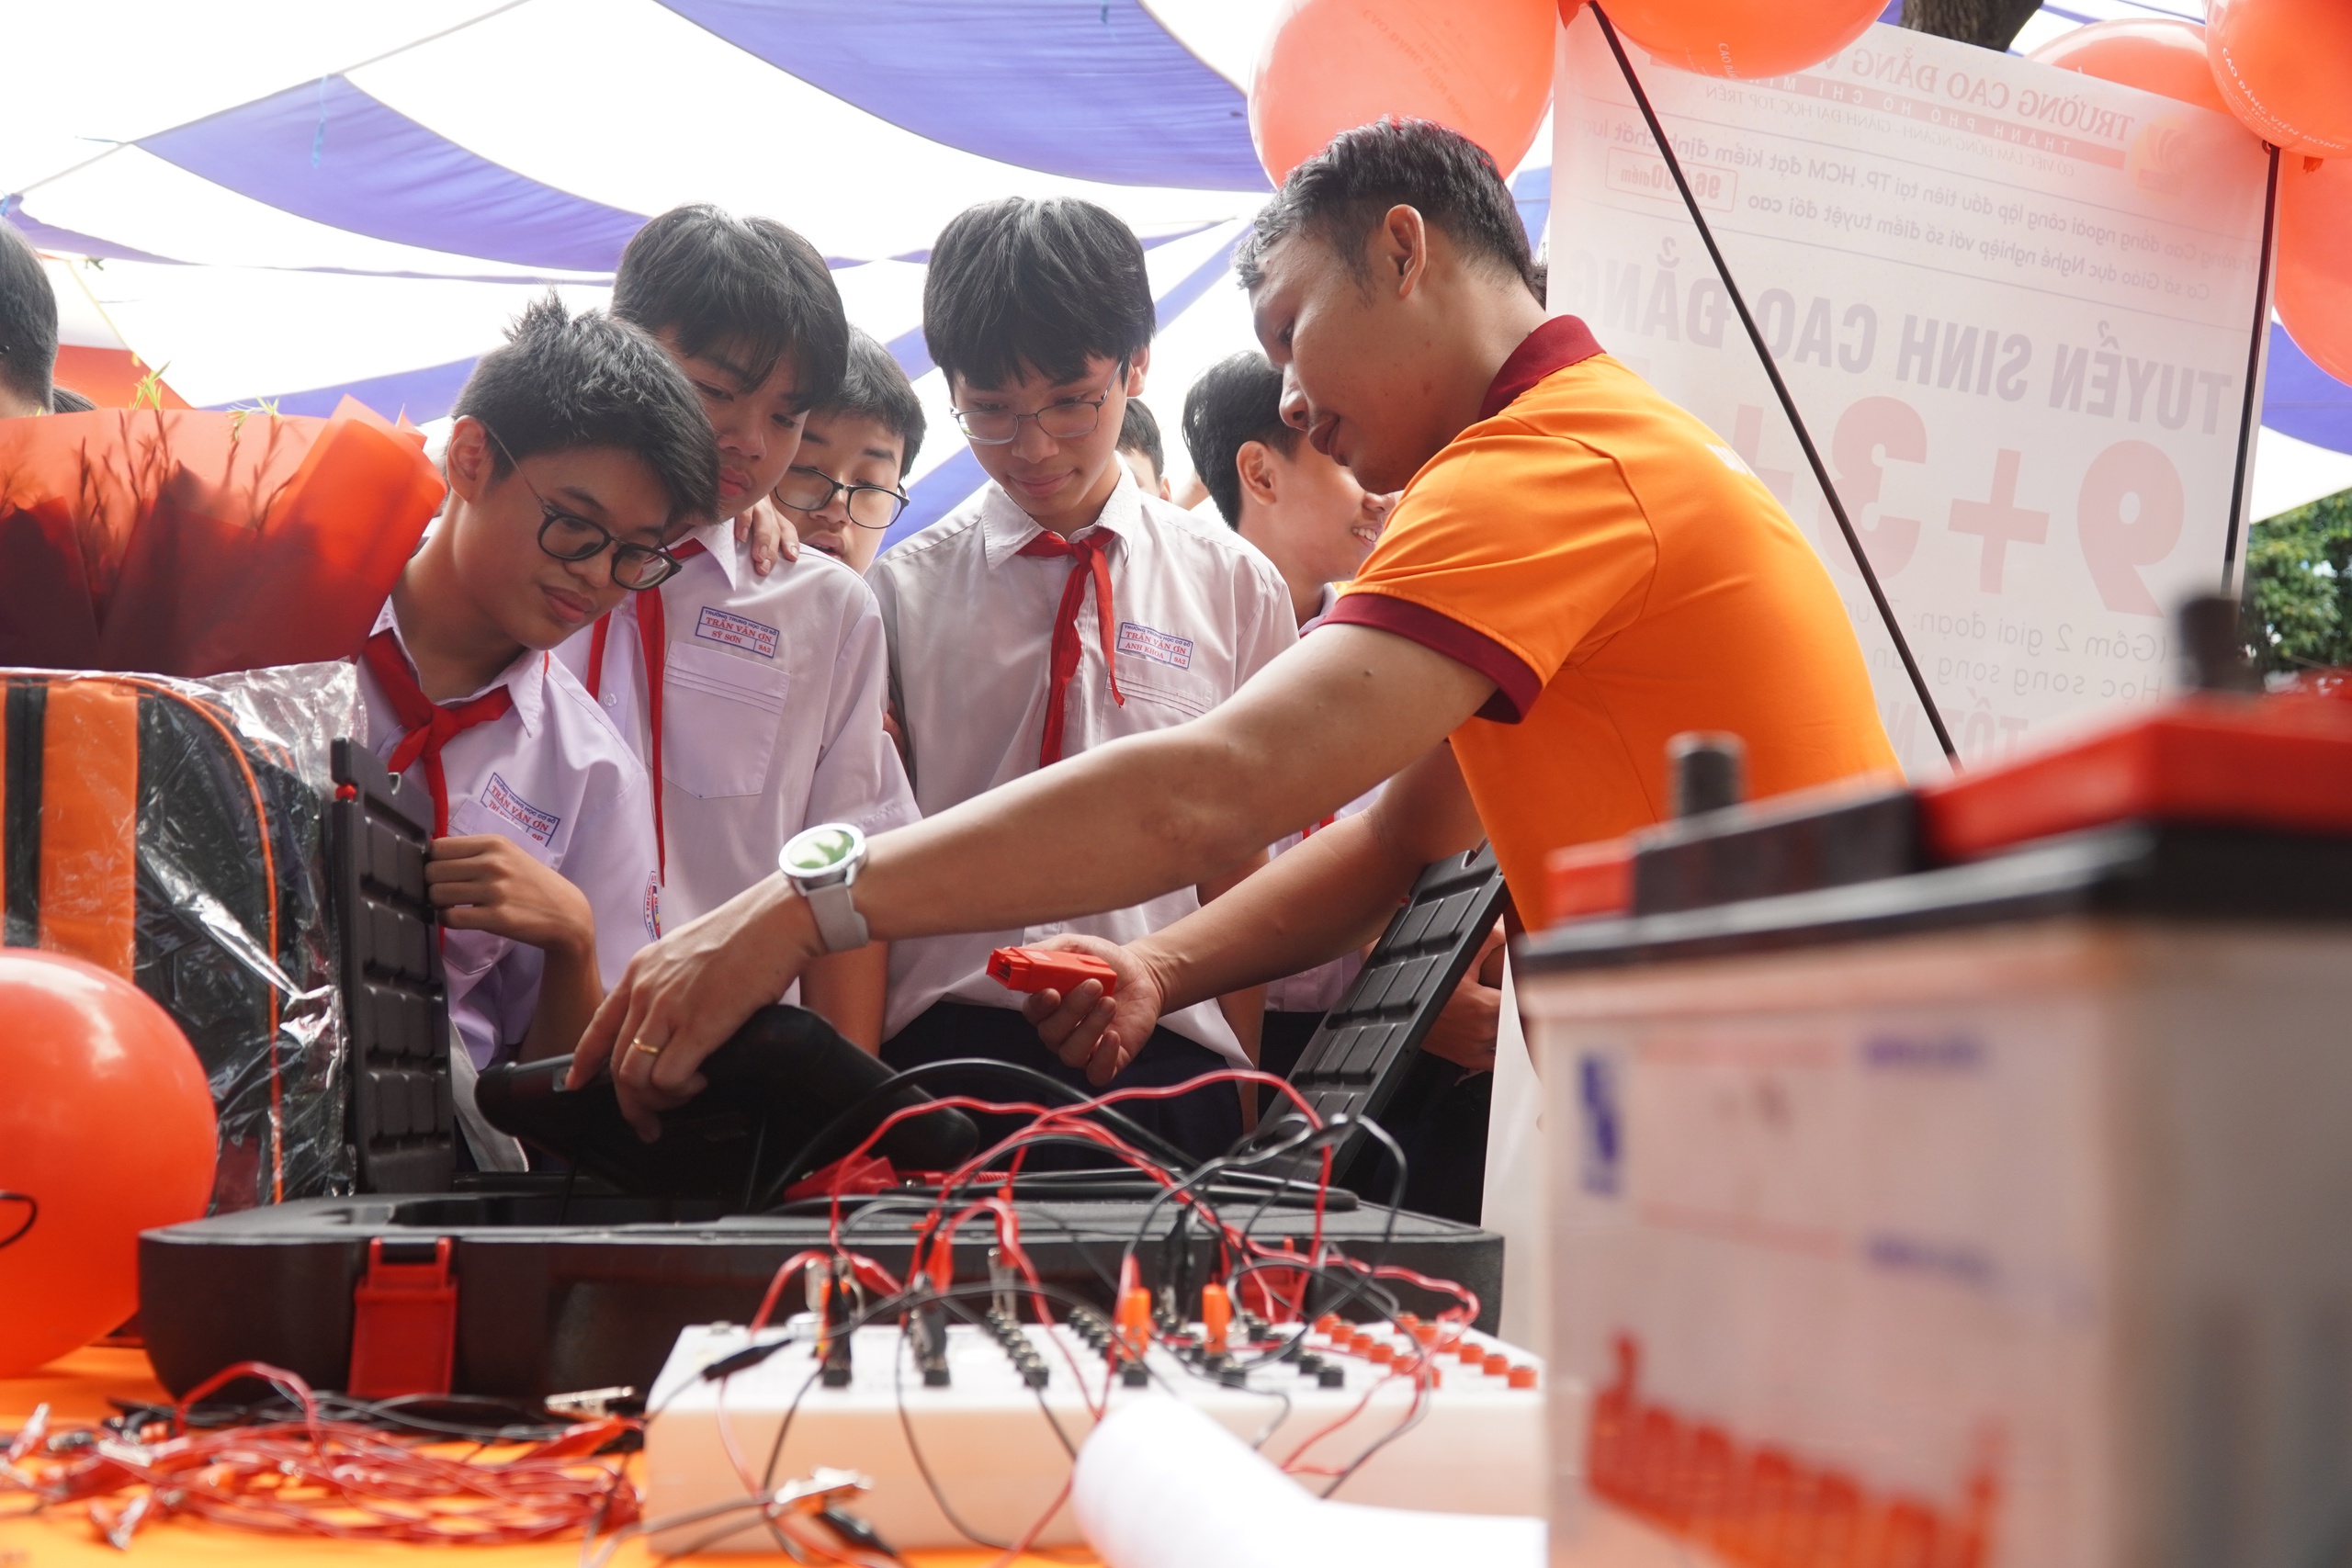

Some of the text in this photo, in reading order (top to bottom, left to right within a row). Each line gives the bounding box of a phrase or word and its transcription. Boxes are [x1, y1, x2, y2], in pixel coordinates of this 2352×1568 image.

[2222, 47, 2238, 77] CAO
[706, 617, 773, 643] TRẦN VĂN ƠN
[725, 635, 742, 644] SƠN
[758, 645, 772, 653] 9A2
[1154, 639, 1171, 650] VĂN
[1173, 646, 1187, 655] ƠN
[1144, 647, 1164, 660] KHOA
[1174, 657, 1186, 665] 9A2
[511, 807, 532, 824] VĂN
[533, 820, 549, 832] ƠN
